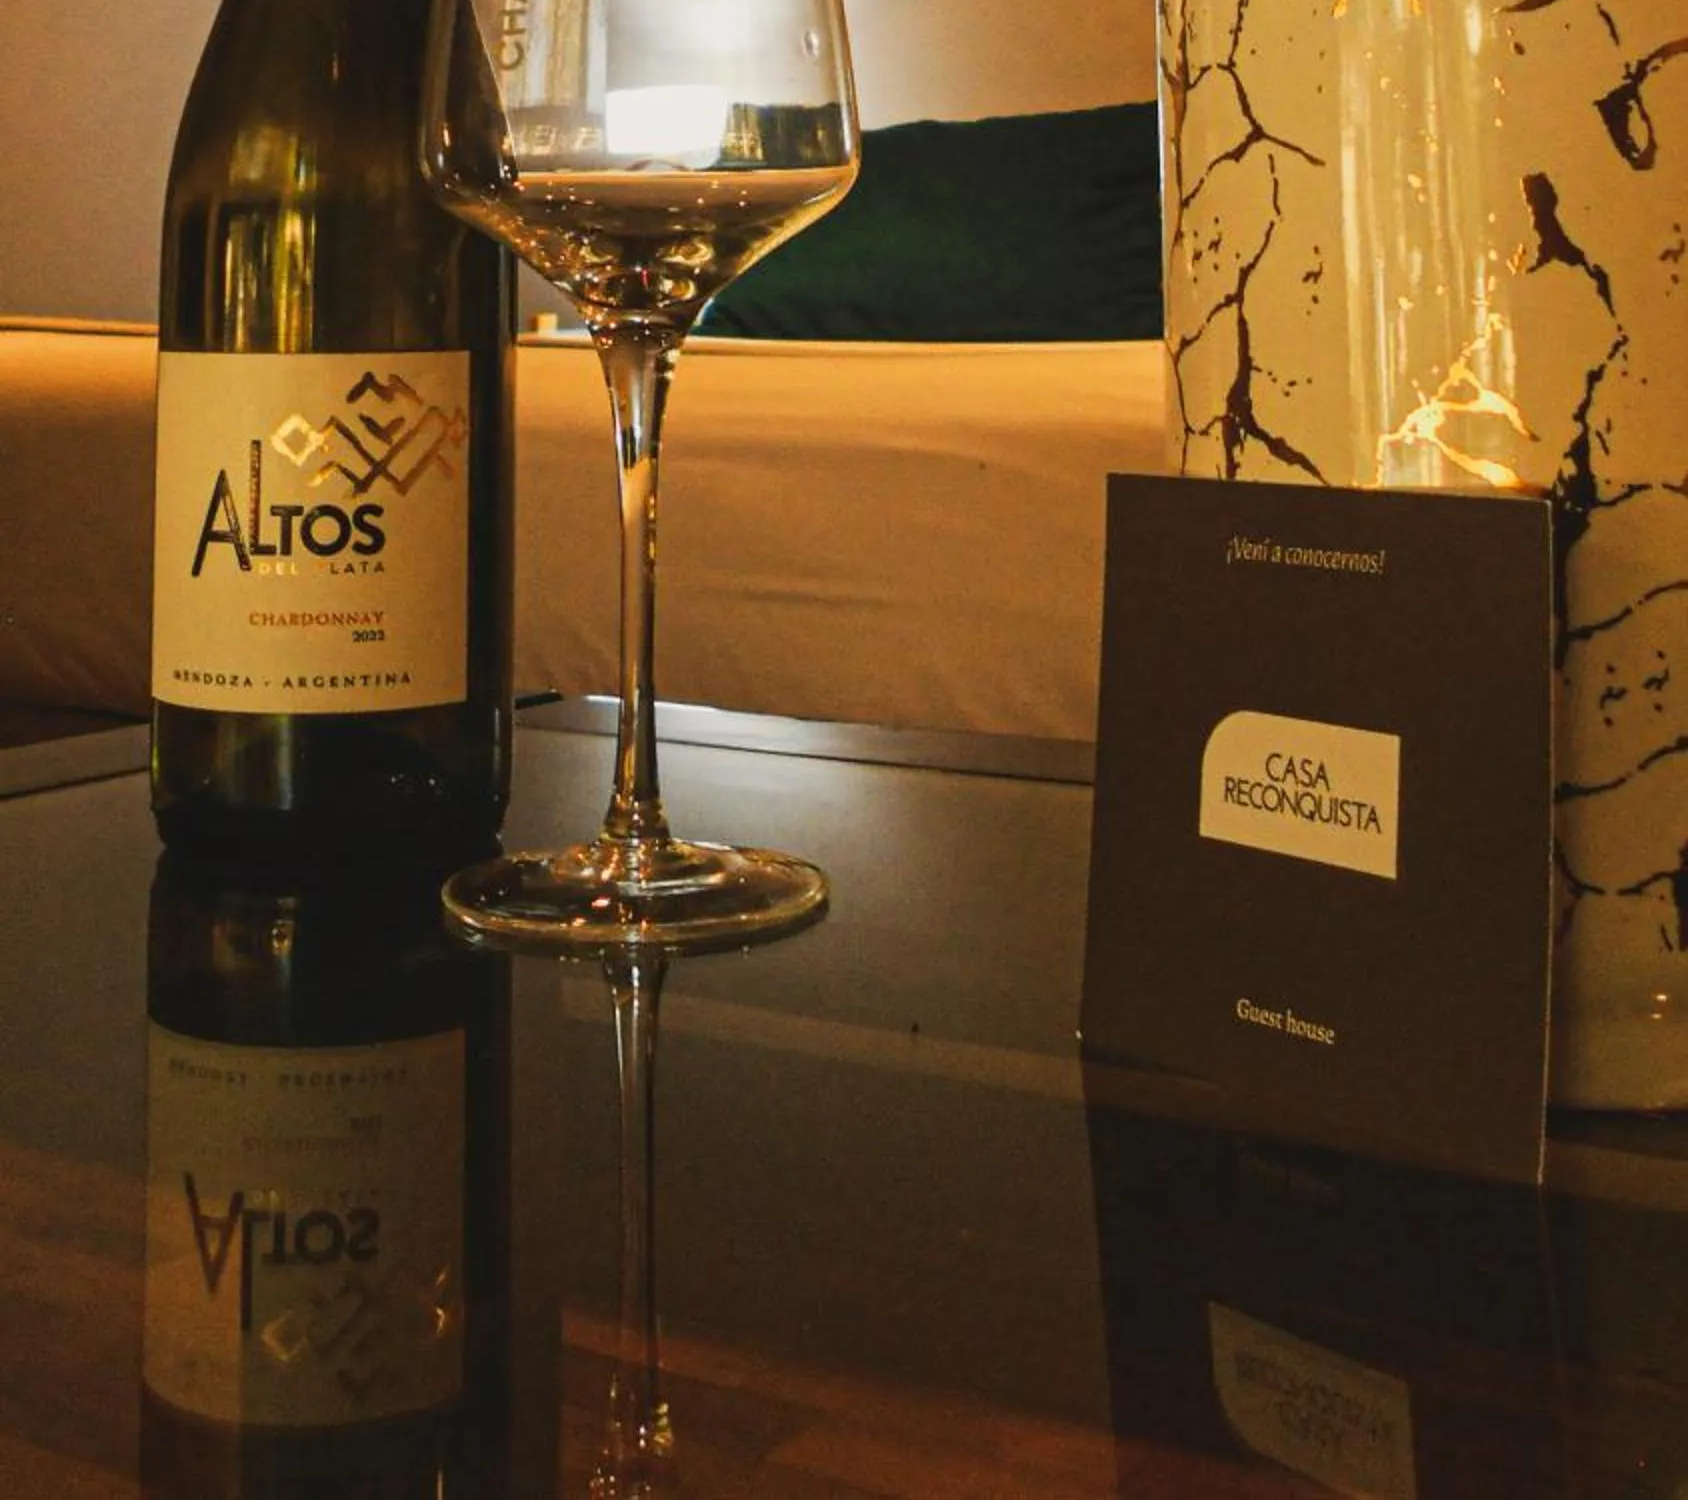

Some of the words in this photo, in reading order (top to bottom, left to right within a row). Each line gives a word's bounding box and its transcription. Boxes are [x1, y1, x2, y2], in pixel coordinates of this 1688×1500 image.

[190, 439, 386, 578] ALTOS
[257, 562, 299, 576] DEL
[313, 561, 386, 575] LATA
[1270, 545, 1282, 563] a
[1284, 547, 1386, 574] conocernos!
[248, 611, 385, 627] CHARDONNAY
[173, 669, 254, 688] MENDOZA
[282, 671, 412, 689] ARGENTINA
[1264, 752, 1331, 793] CASA
[1223, 775, 1383, 836] RECONQUISTA
[1236, 998, 1283, 1029] Guest
[1286, 1008, 1336, 1045] house
